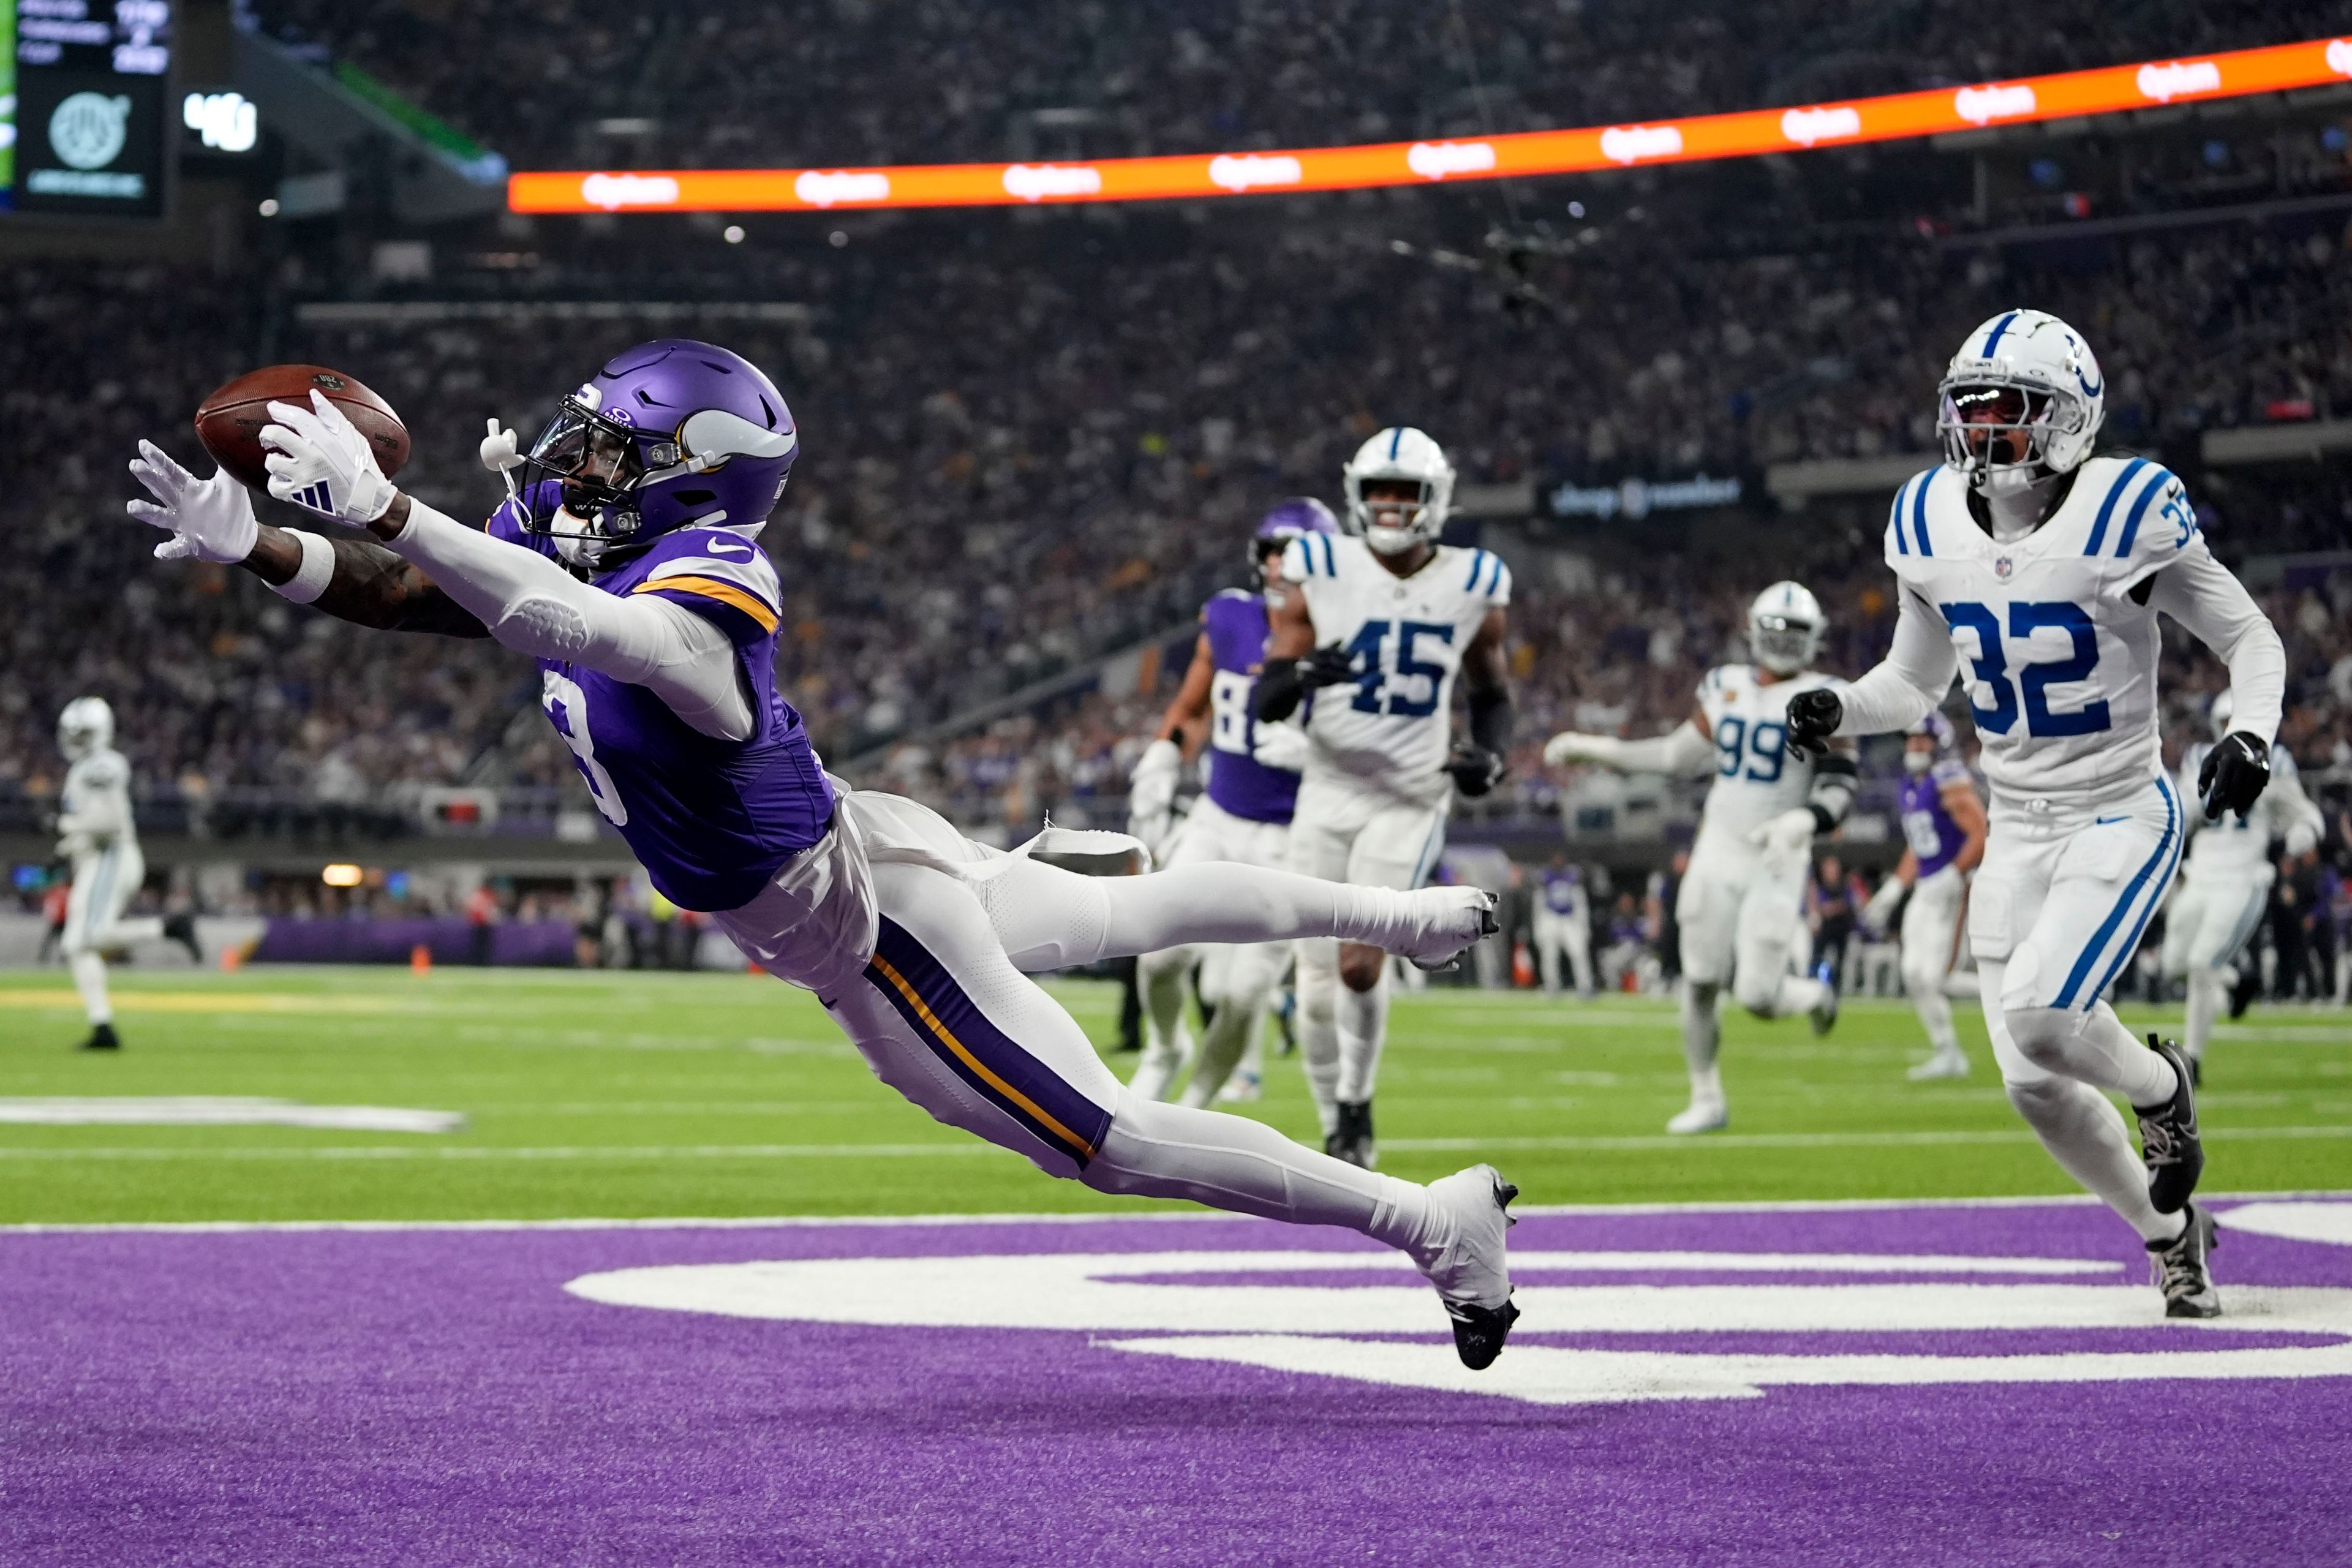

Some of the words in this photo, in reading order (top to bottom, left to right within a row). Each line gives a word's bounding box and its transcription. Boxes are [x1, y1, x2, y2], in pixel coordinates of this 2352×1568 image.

[1346, 619, 1455, 717] 45
[1939, 601, 2111, 738] 32
[1717, 716, 1789, 783] 99
